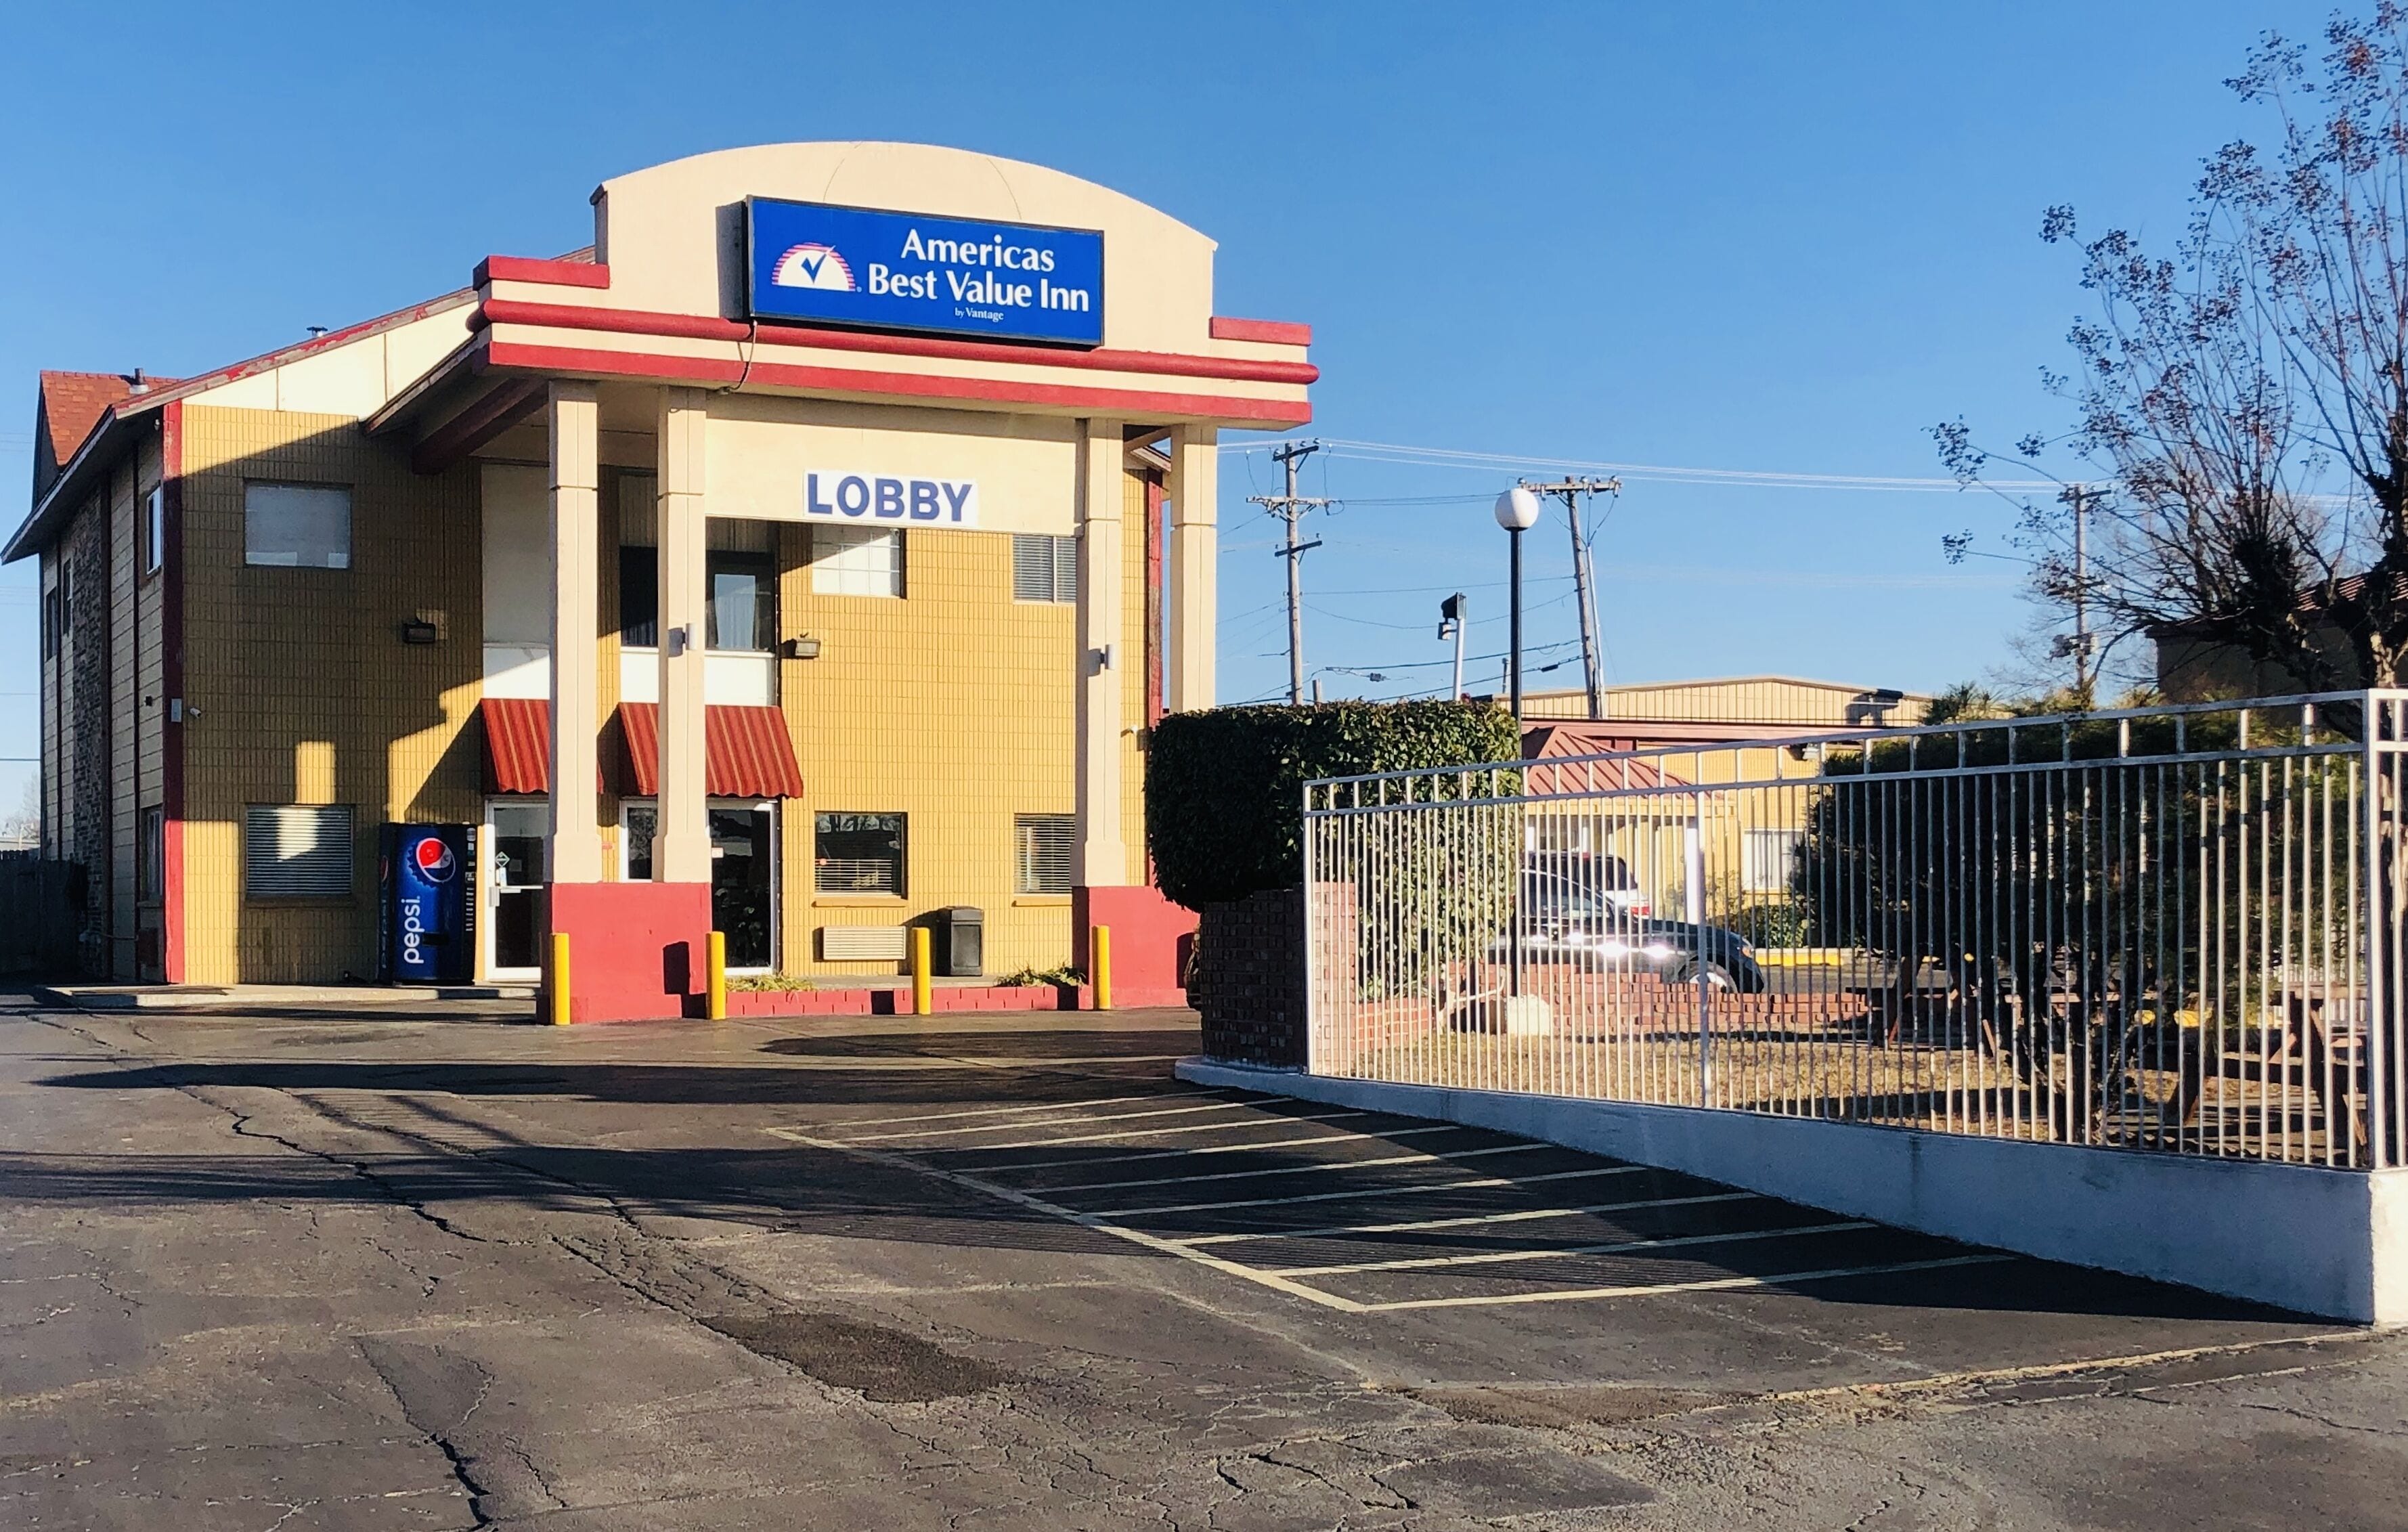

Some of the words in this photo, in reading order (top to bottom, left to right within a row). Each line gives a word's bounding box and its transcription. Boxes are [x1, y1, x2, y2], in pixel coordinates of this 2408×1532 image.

[901, 229, 1055, 272] Americas
[869, 263, 938, 300] Best
[946, 270, 1032, 307] Value
[1041, 278, 1089, 312] Inn
[955, 307, 964, 319] by
[965, 307, 1004, 323] Vantage
[808, 473, 972, 522] LOBBY
[401, 898, 426, 964] pepsi
